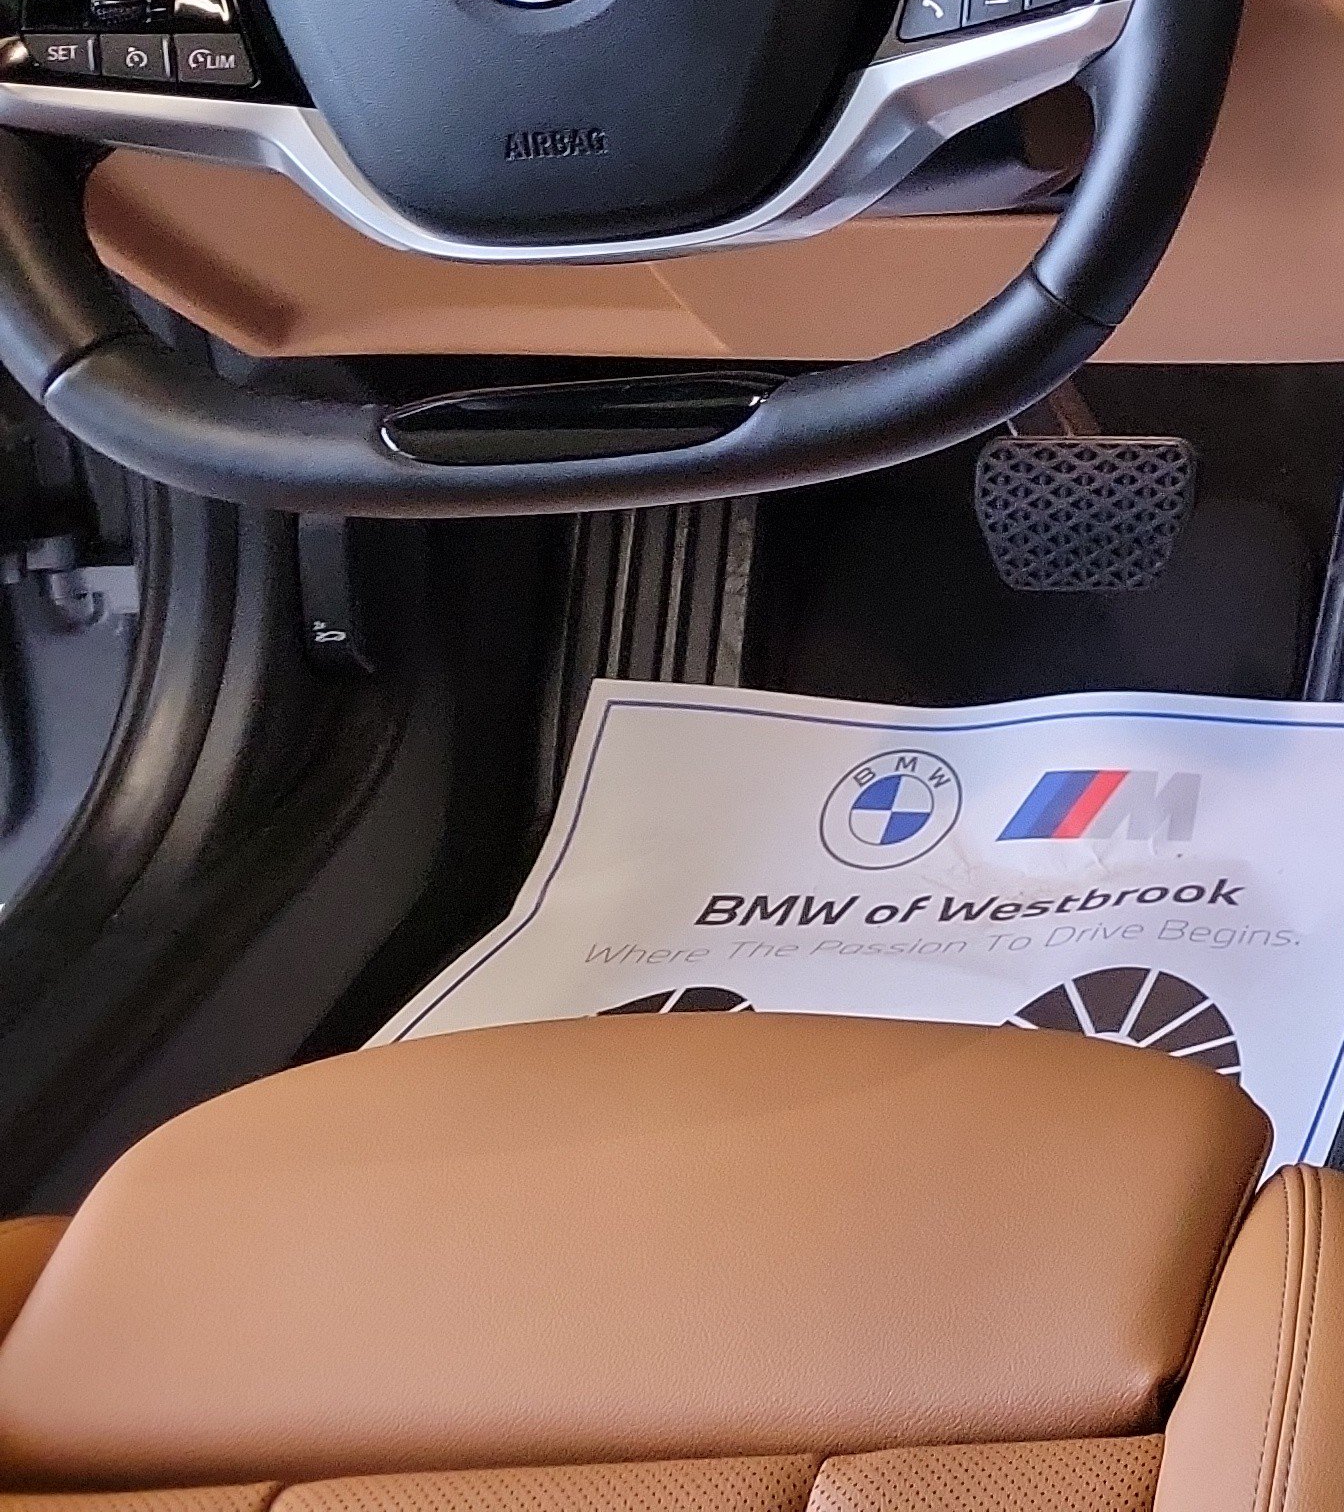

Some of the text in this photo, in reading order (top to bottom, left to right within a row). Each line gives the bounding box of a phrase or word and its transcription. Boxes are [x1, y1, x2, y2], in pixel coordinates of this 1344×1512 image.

[48, 45, 78, 61] SET
[206, 54, 236, 69] LIM
[503, 128, 609, 161] AIRBAG
[852, 755, 952, 789] BMW
[694, 878, 1245, 926] BMW of Westbrook
[584, 918, 1302, 964] Where The Passion To Drive Begins.
